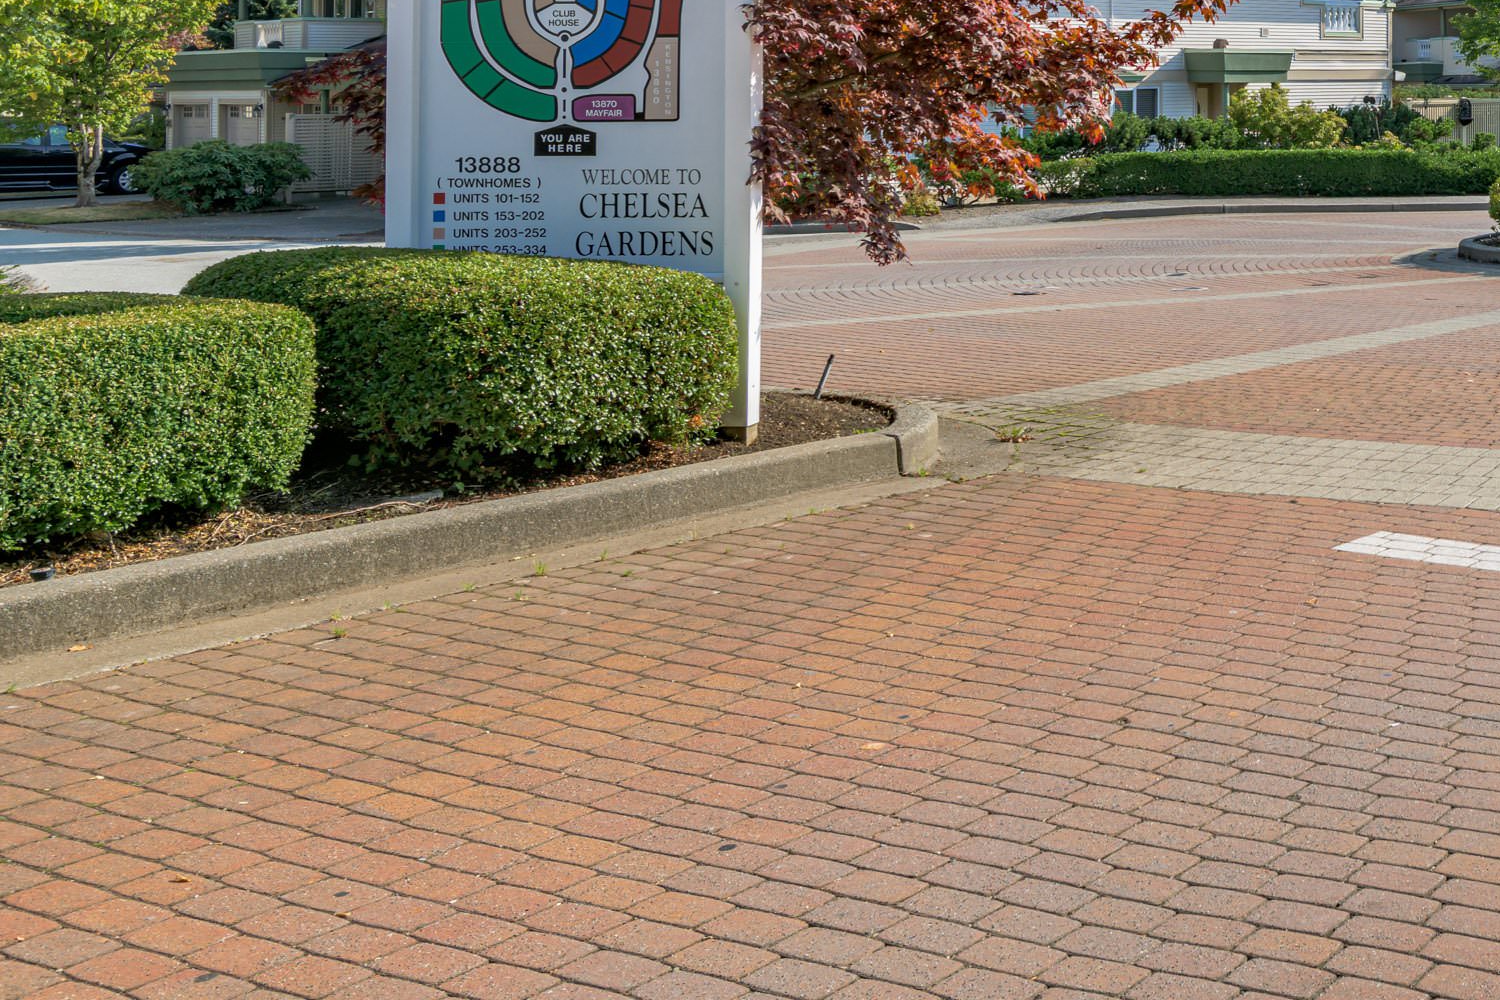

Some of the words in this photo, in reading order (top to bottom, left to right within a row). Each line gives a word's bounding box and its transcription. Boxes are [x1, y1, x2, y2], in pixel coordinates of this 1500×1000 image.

[552, 9, 576, 18] CLUB
[548, 19, 580, 27] HOUSE
[664, 44, 672, 115] KENSINGTON
[591, 100, 618, 108] 13870
[585, 109, 623, 117] MAYFAIR
[540, 134, 563, 143] YOU
[568, 134, 590, 143] ARE
[548, 144, 582, 153] HERE
[455, 157, 520, 173] 13888
[582, 168, 670, 185] WELCOME
[676, 168, 702, 185] TO
[447, 178, 531, 188] TOWNHOMES
[453, 193, 489, 203] UNITS
[495, 193, 540, 203] 101-152
[579, 193, 709, 218] CHELSEA
[453, 211, 489, 221] UNITS
[495, 211, 545, 221] 153-202
[453, 228, 489, 238] UNITS
[494, 228, 547, 238] 203-252
[575, 231, 713, 256] GARDENS
[494, 245, 547, 255] 253-334
